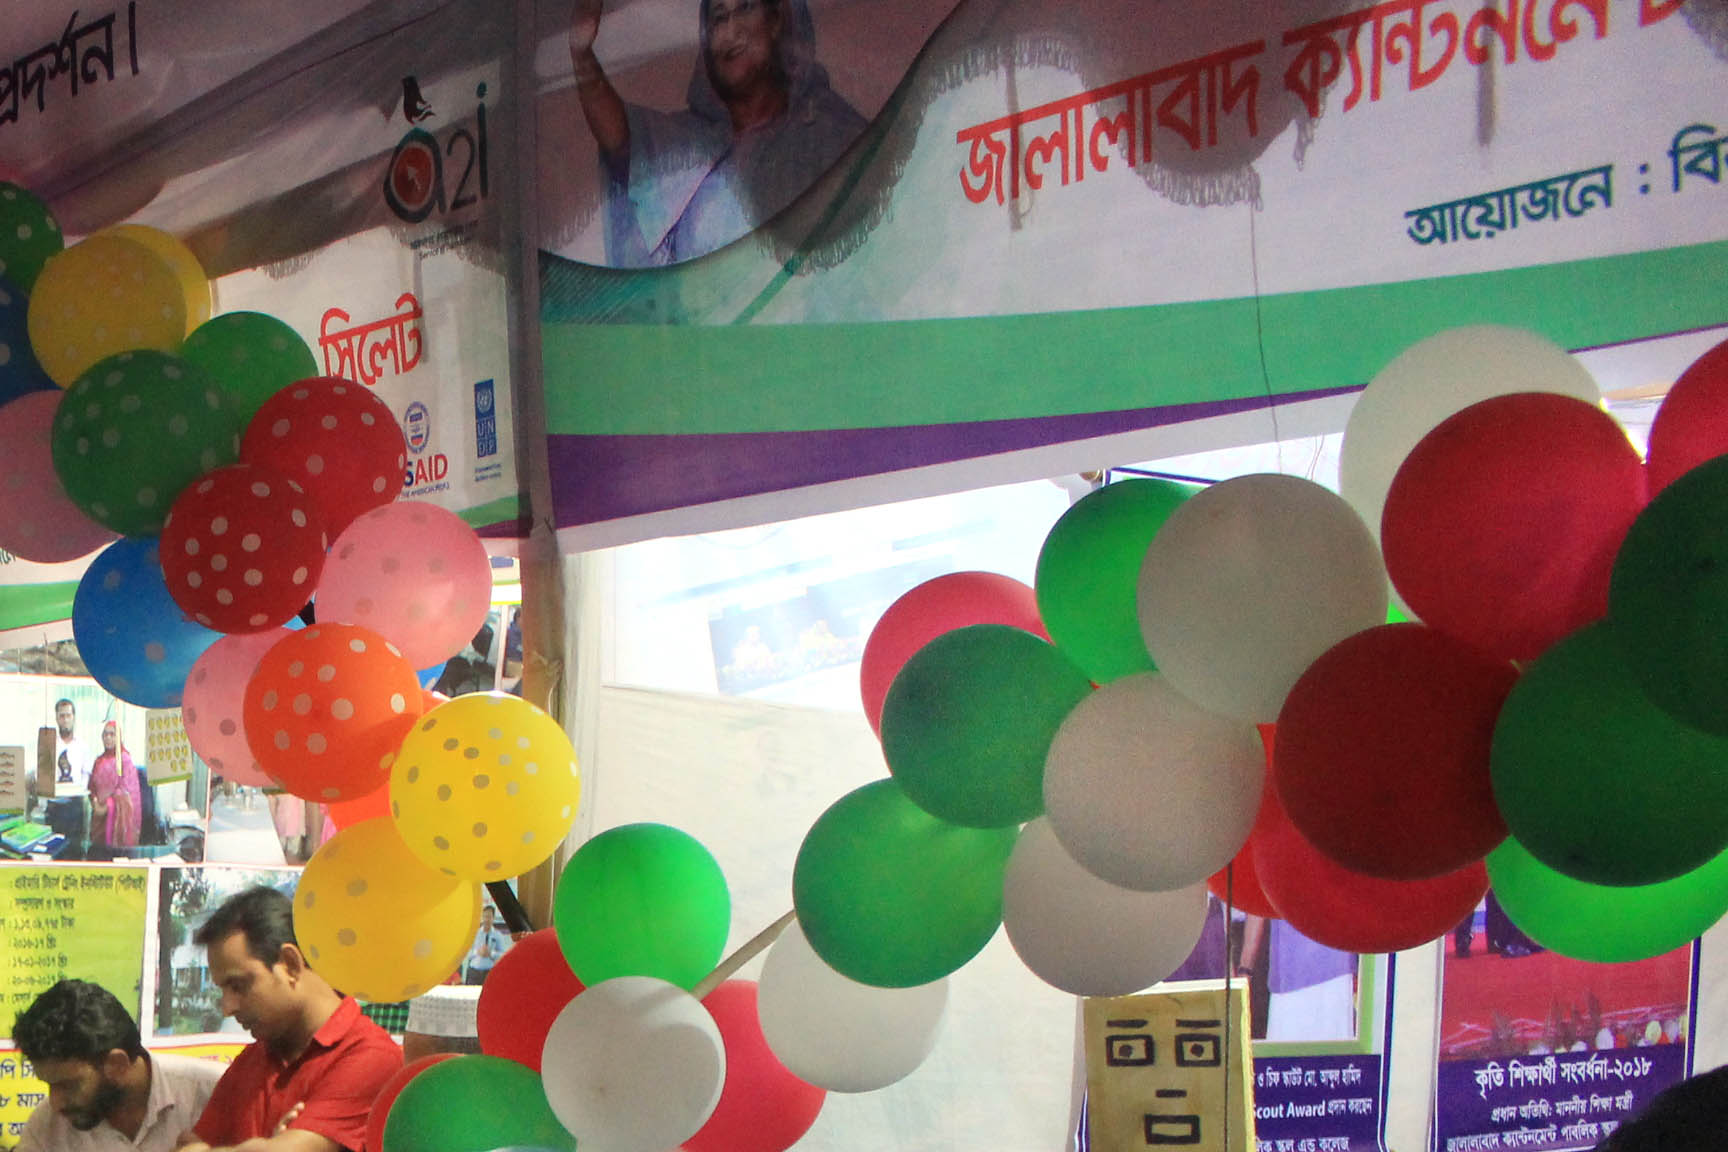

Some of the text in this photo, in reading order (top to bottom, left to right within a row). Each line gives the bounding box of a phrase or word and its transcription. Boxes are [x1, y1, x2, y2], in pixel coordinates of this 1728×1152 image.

[956, 40, 1264, 207] জালালাবাদ
[1404, 164, 1616, 247] আয়োজনে
[1667, 124, 1728, 194] বি
[318, 292, 424, 385] সিলেট
[403, 453, 449, 487] SAID
[1474, 1053, 1652, 1100] কৃতি শিক্ষার্থী সংবর্ধনা-২০১৮
[1287, 1100, 1326, 1119] Award
[1491, 1105, 1516, 1124] প্রধান
[1589, 1091, 1613, 1114] শিক্ষা
[1319, 1135, 1351, 1152] কলেজ
